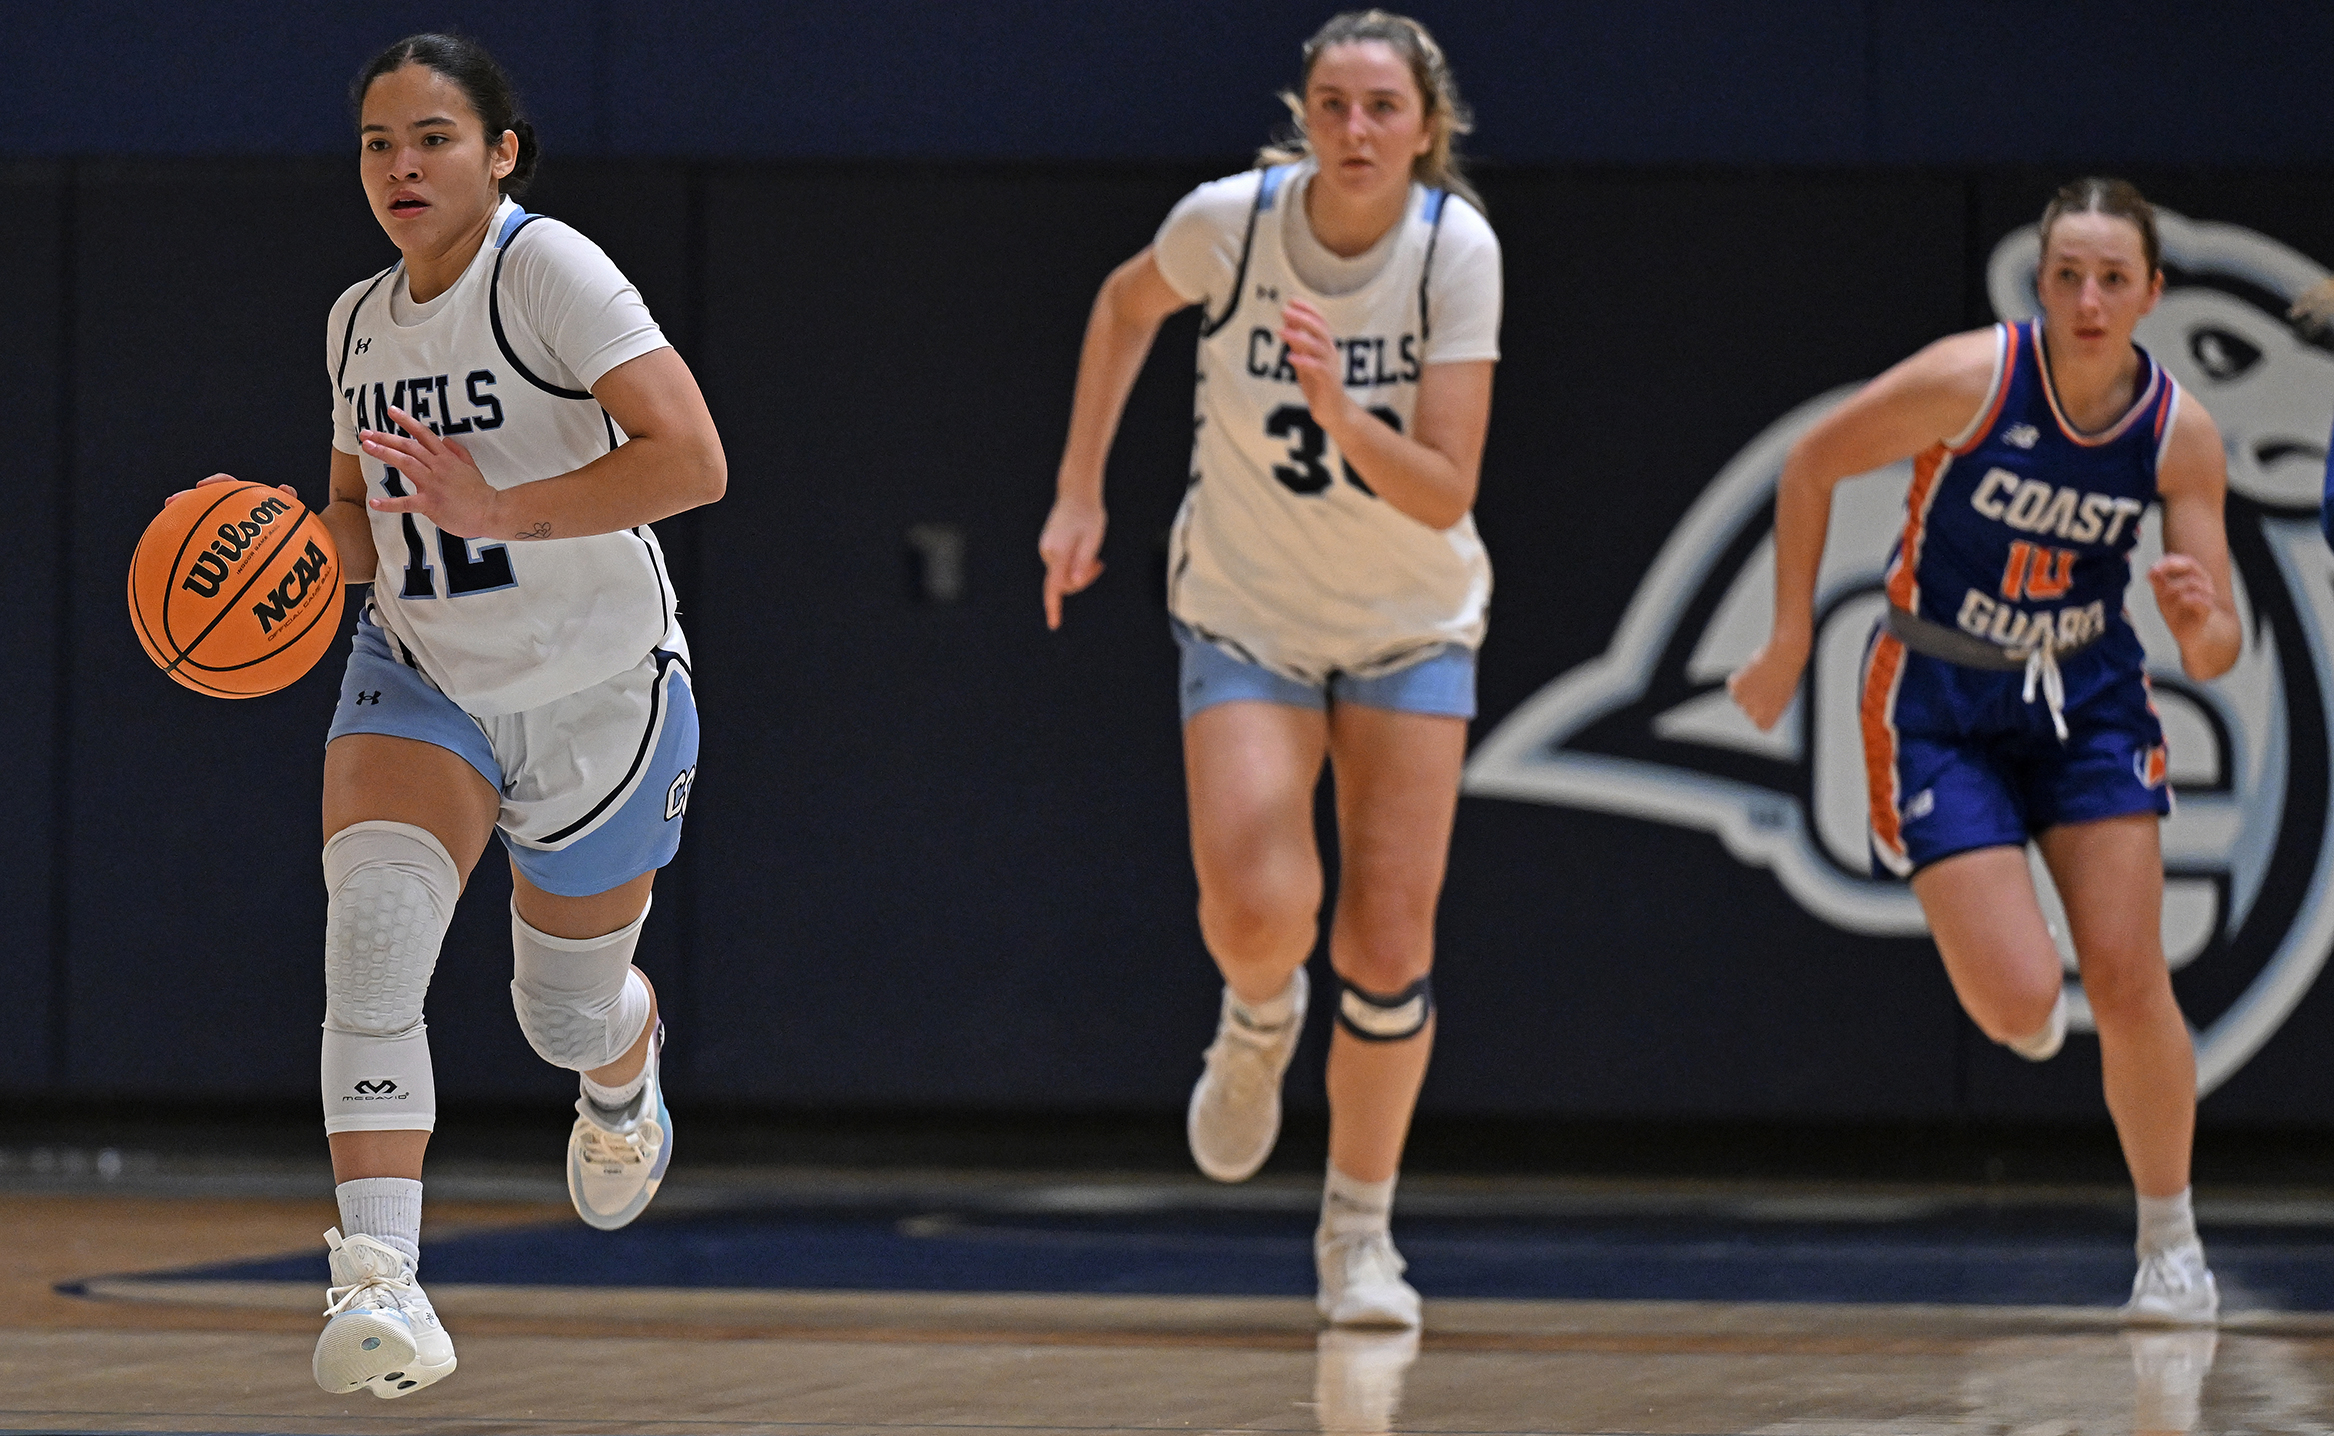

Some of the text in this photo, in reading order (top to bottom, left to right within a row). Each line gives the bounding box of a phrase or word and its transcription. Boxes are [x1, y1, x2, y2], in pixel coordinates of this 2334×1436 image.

[1248, 327, 1420, 386] CAELS
[1970, 465, 2142, 546] COAST
[181, 497, 291, 599] Wilson
[237, 551, 255, 576] INDOOR
[252, 540, 328, 634] NCAA
[267, 609, 303, 642] OFFICIAL
